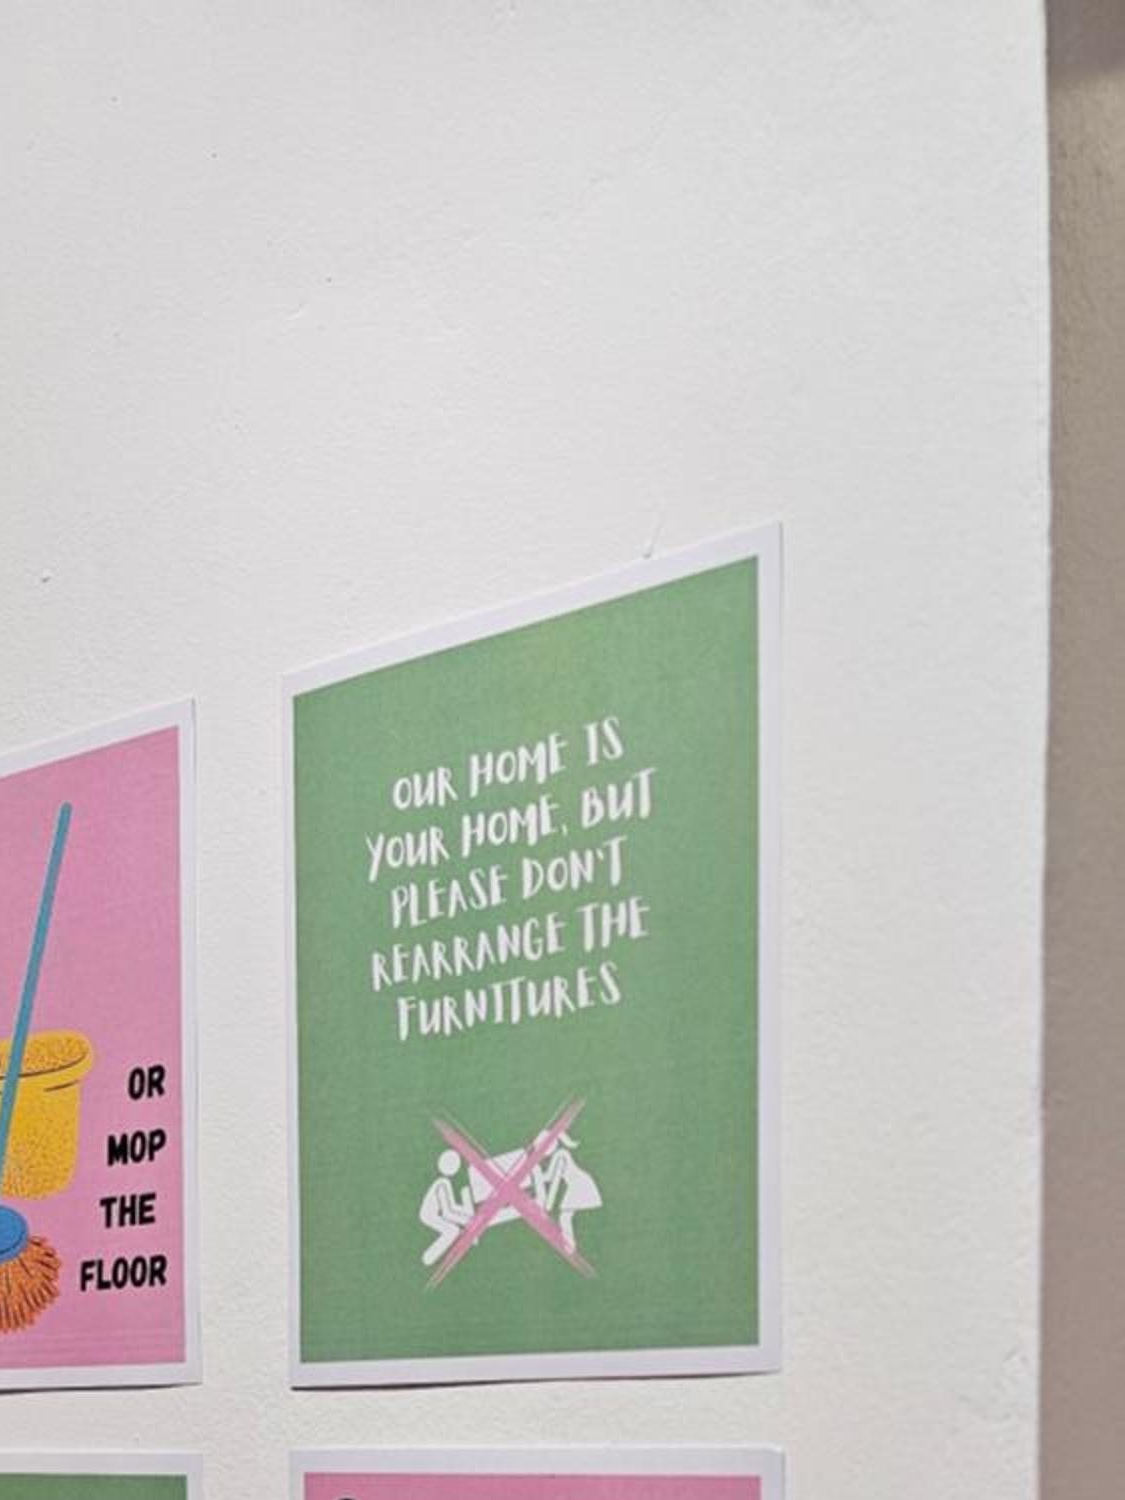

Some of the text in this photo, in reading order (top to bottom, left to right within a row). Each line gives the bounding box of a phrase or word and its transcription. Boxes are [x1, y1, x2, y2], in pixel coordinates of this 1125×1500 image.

[393, 716, 624, 809] OUR HOME IS
[365, 767, 656, 883] YOUR HOME, BUT
[391, 836, 626, 928] PLEASE DON'T
[372, 896, 650, 991] REARRANGE THE
[397, 961, 622, 1041] FURNITURES
[128, 1064, 166, 1100] OR
[107, 1129, 167, 1167] MOP
[100, 1192, 156, 1229] THE
[80, 1254, 167, 1292] FLOOR
